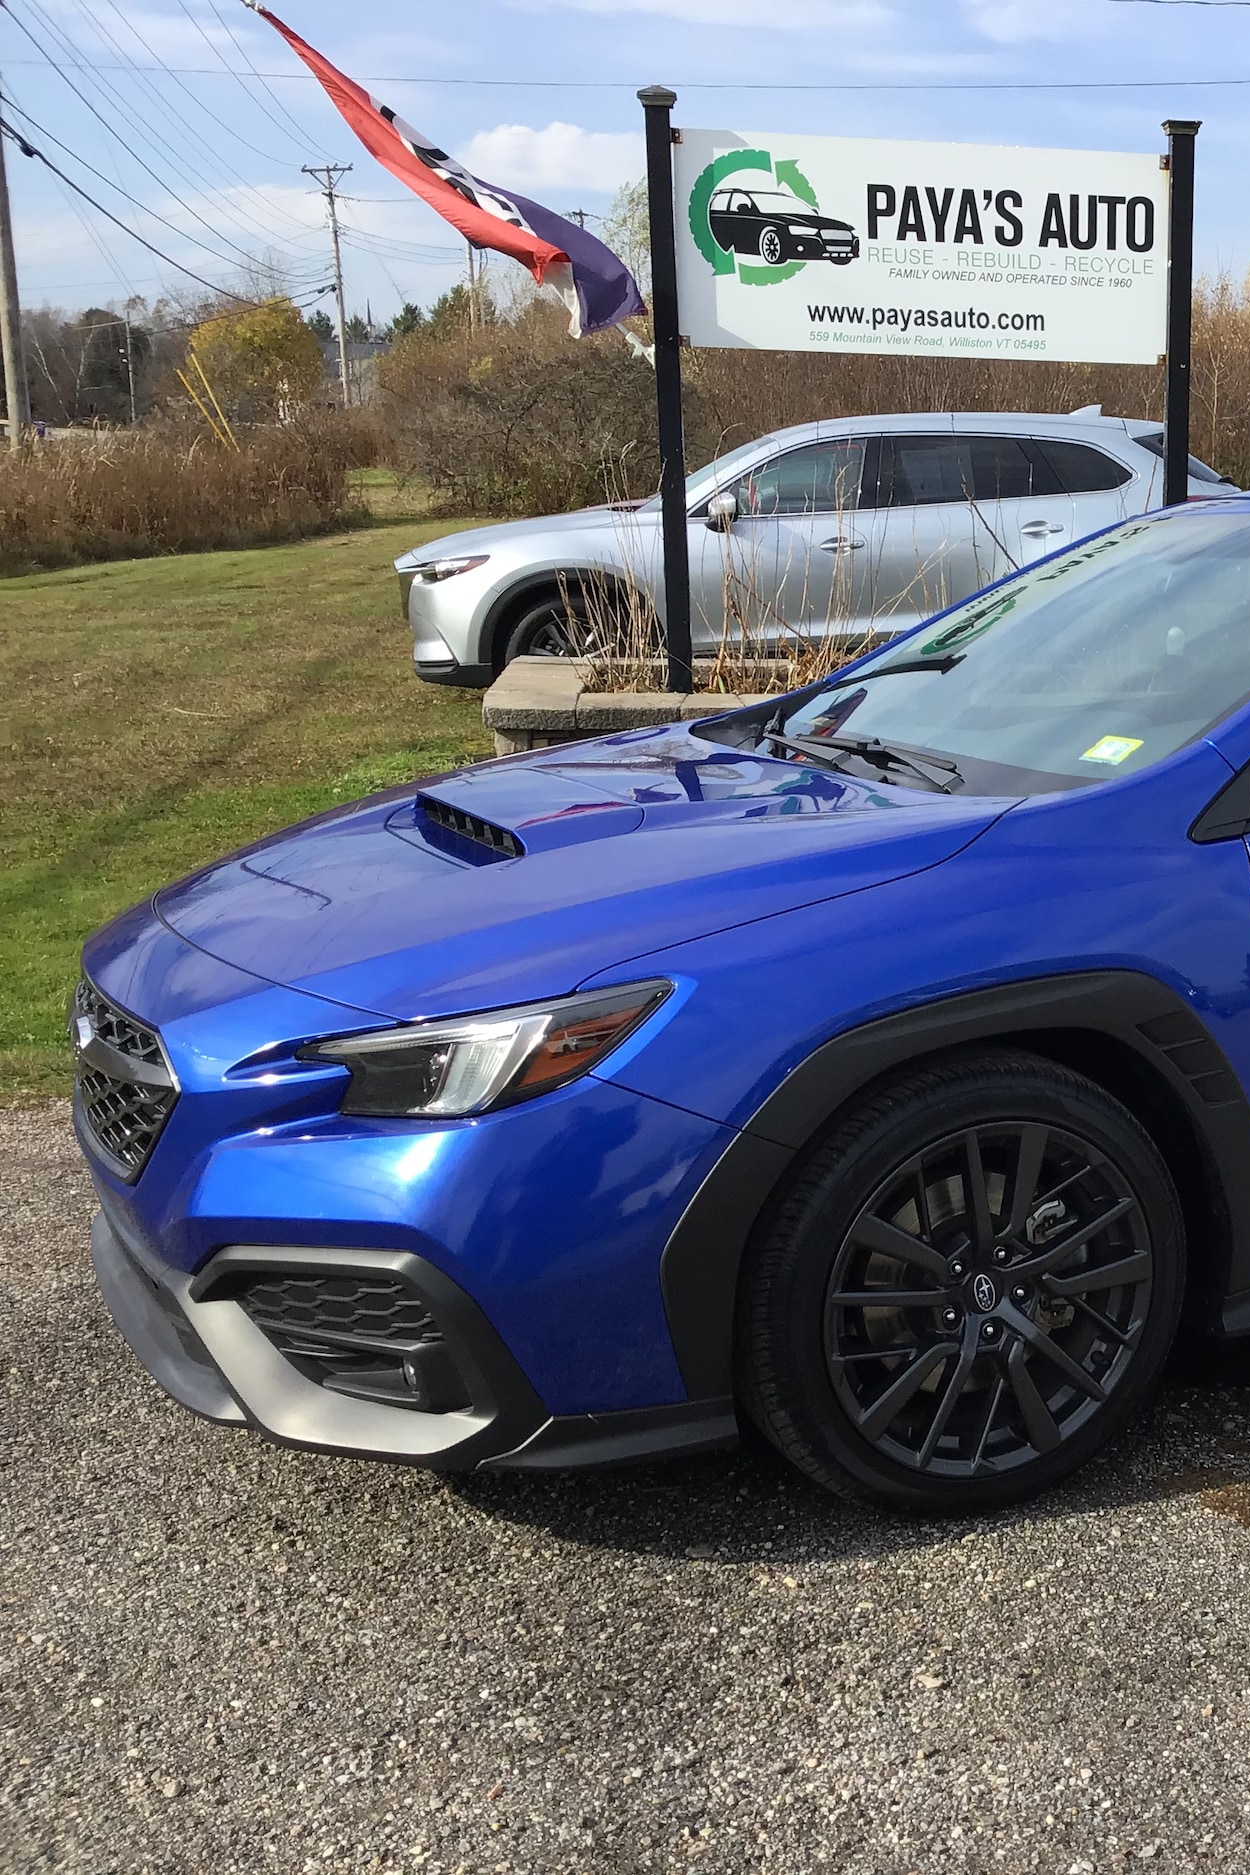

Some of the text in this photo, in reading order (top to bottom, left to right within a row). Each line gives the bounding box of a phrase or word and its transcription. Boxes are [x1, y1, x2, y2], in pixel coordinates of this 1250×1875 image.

[866, 183, 1155, 253] PAYA'S AUTO
[867, 246, 935, 266] REUSE
[957, 251, 1042, 271] REBUILD
[1064, 255, 1154, 275] RECYCLE
[888, 267, 1133, 289] FAMILY OWNED AND OPERATED SINCE 1960
[807, 304, 1045, 332] www.payasauto.com
[808, 330, 1047, 351] 559 Mountain View Road, Williston VT 05495
